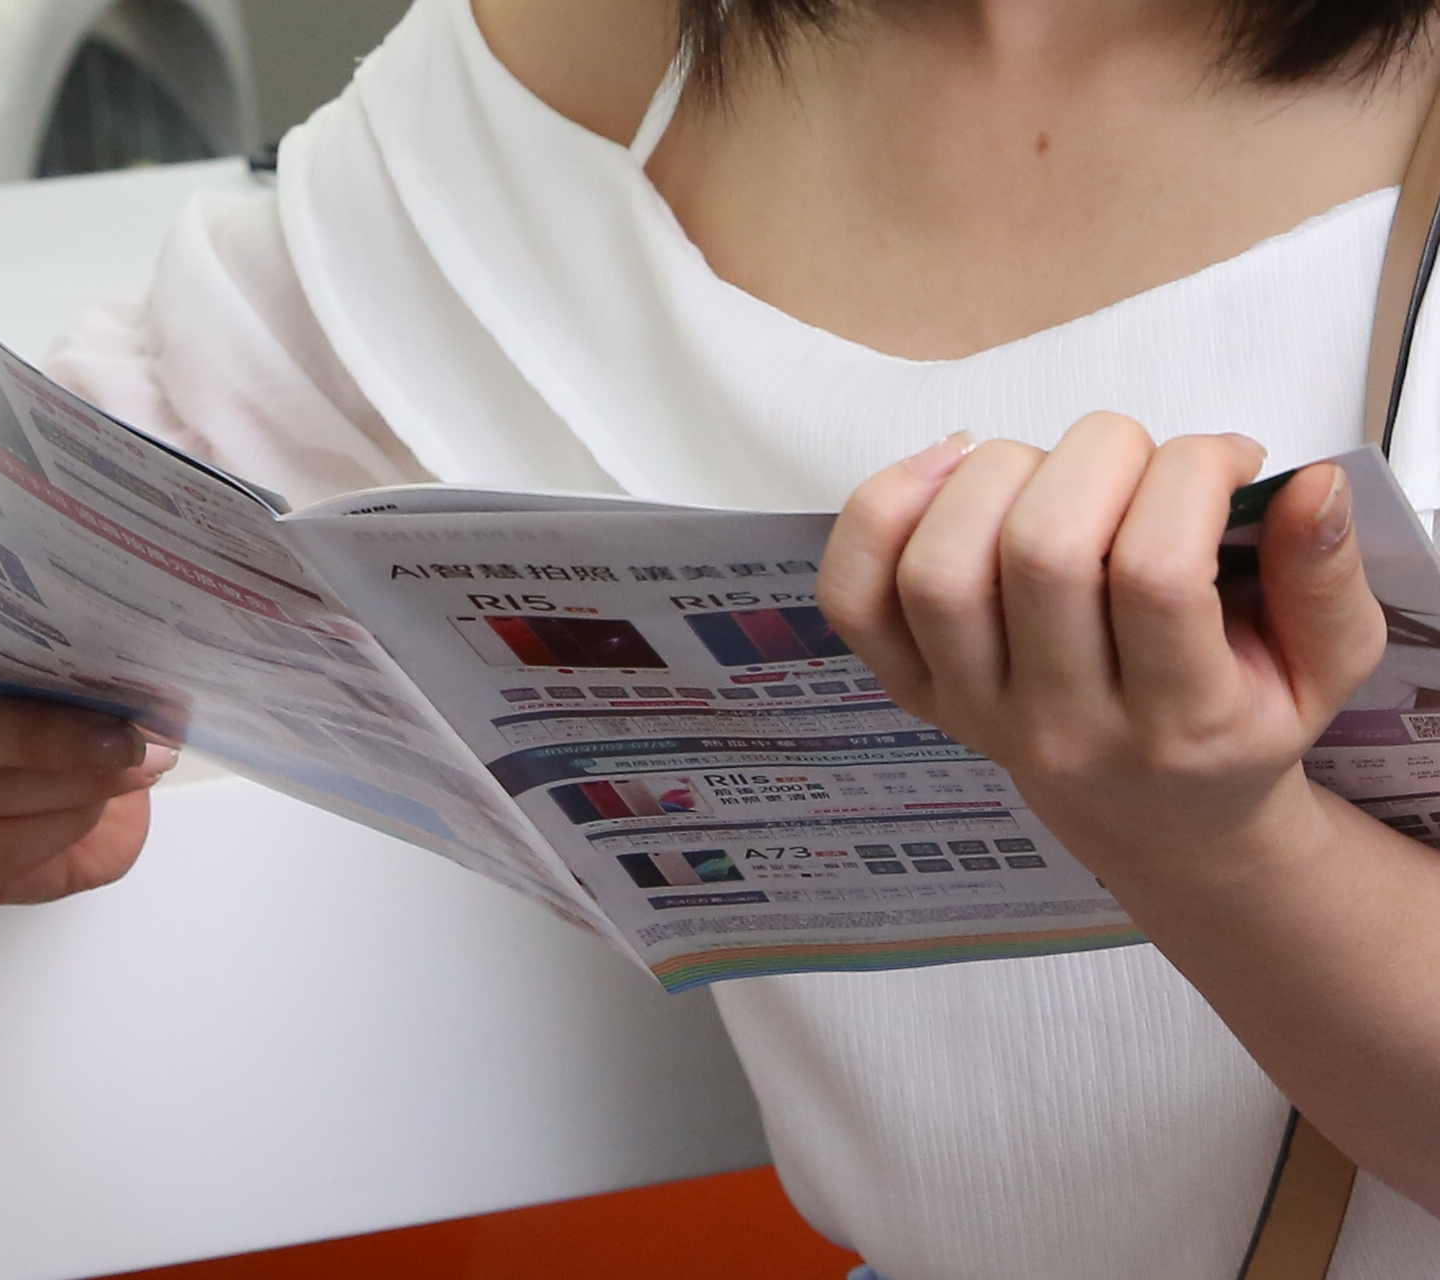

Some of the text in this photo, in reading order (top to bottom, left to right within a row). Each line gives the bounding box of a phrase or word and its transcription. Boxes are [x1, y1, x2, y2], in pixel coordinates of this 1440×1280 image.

[390, 563, 620, 582] AI智慧拍照
[466, 594, 557, 612] R15
[669, 591, 762, 610] R15
[784, 747, 960, 762] Nintendo Switch
[703, 773, 771, 787] R11s
[744, 846, 813, 860] A73
